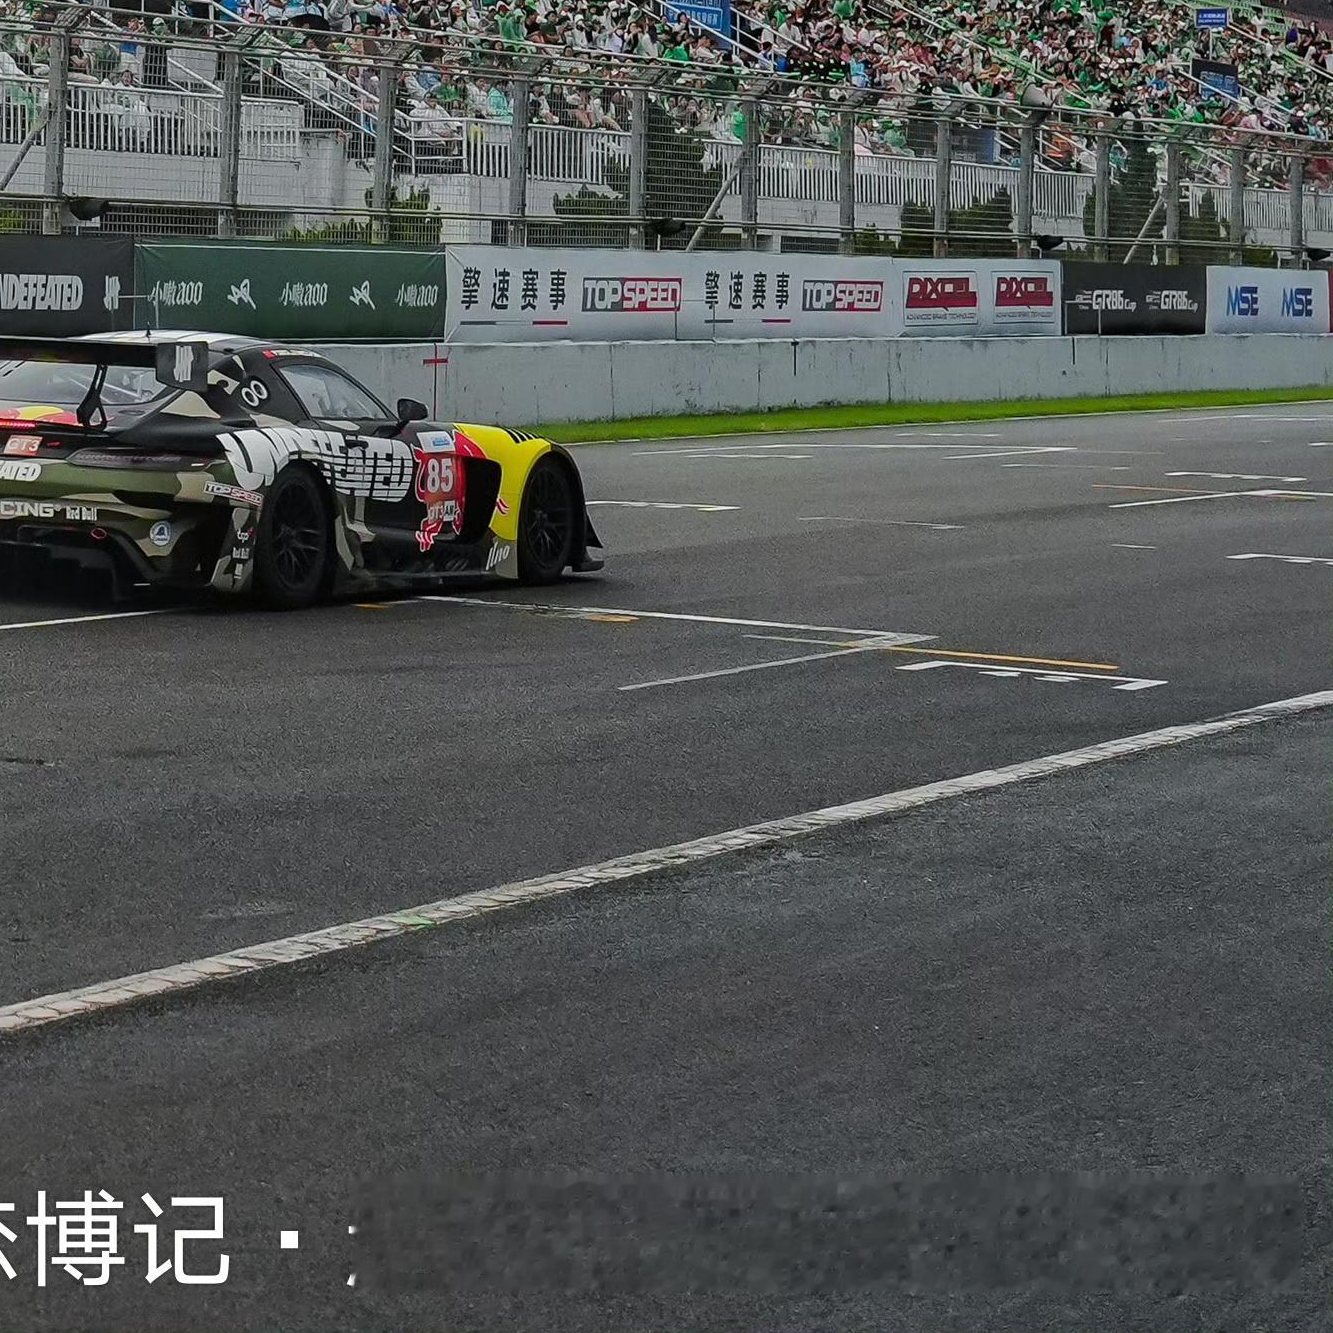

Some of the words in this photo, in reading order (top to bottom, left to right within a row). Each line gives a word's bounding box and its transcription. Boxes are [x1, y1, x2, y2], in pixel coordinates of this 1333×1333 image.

[461, 266, 567, 311] 擎速赛事
[705, 271, 790, 310] 擎速赛事
[1092, 289, 1124, 310] GR86
[1227, 286, 1260, 316] MSE
[1281, 288, 1313, 317] MSE
[7, 437, 40, 452] GT3
[427, 458, 453, 493] 85
